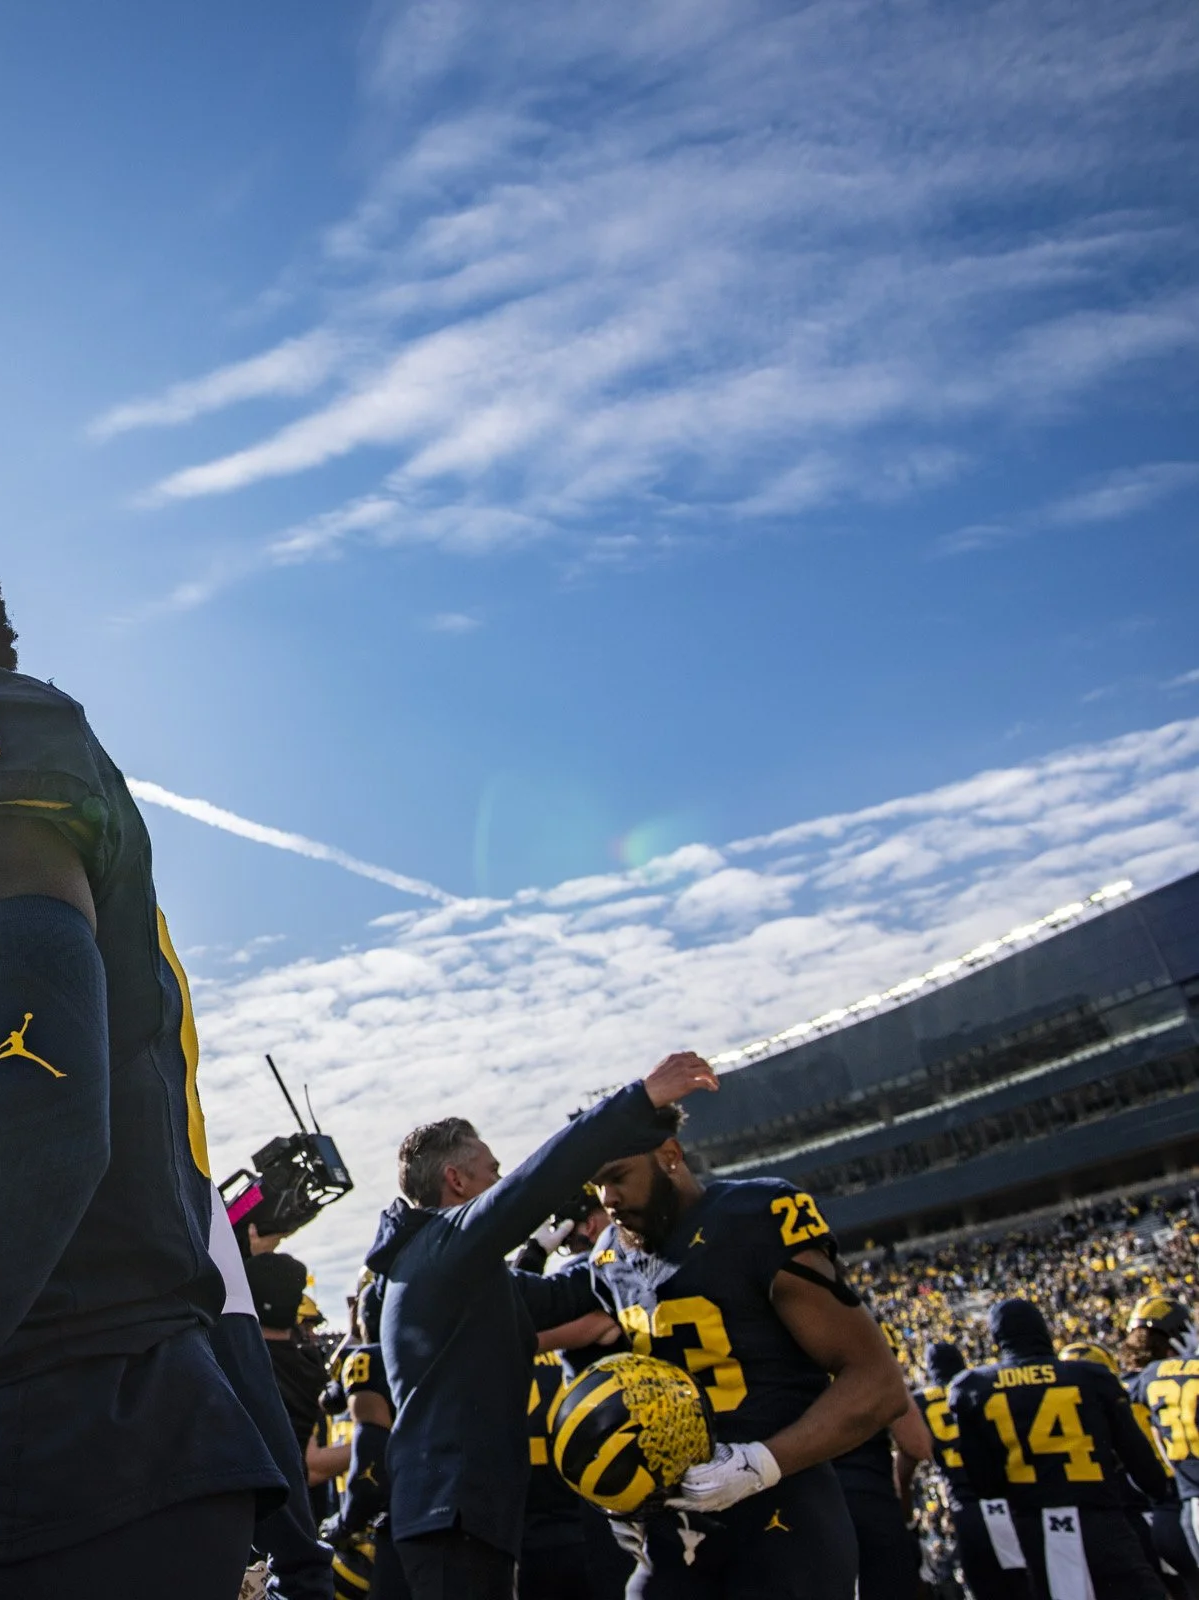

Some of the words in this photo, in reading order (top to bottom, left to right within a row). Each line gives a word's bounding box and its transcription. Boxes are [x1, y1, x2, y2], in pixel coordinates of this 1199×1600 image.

[770, 1192, 830, 1246] 23
[993, 1364, 1058, 1389] JONES
[983, 1386, 1105, 1483] 14
[986, 1504, 1006, 1515] M
[1049, 1516, 1075, 1532] M
